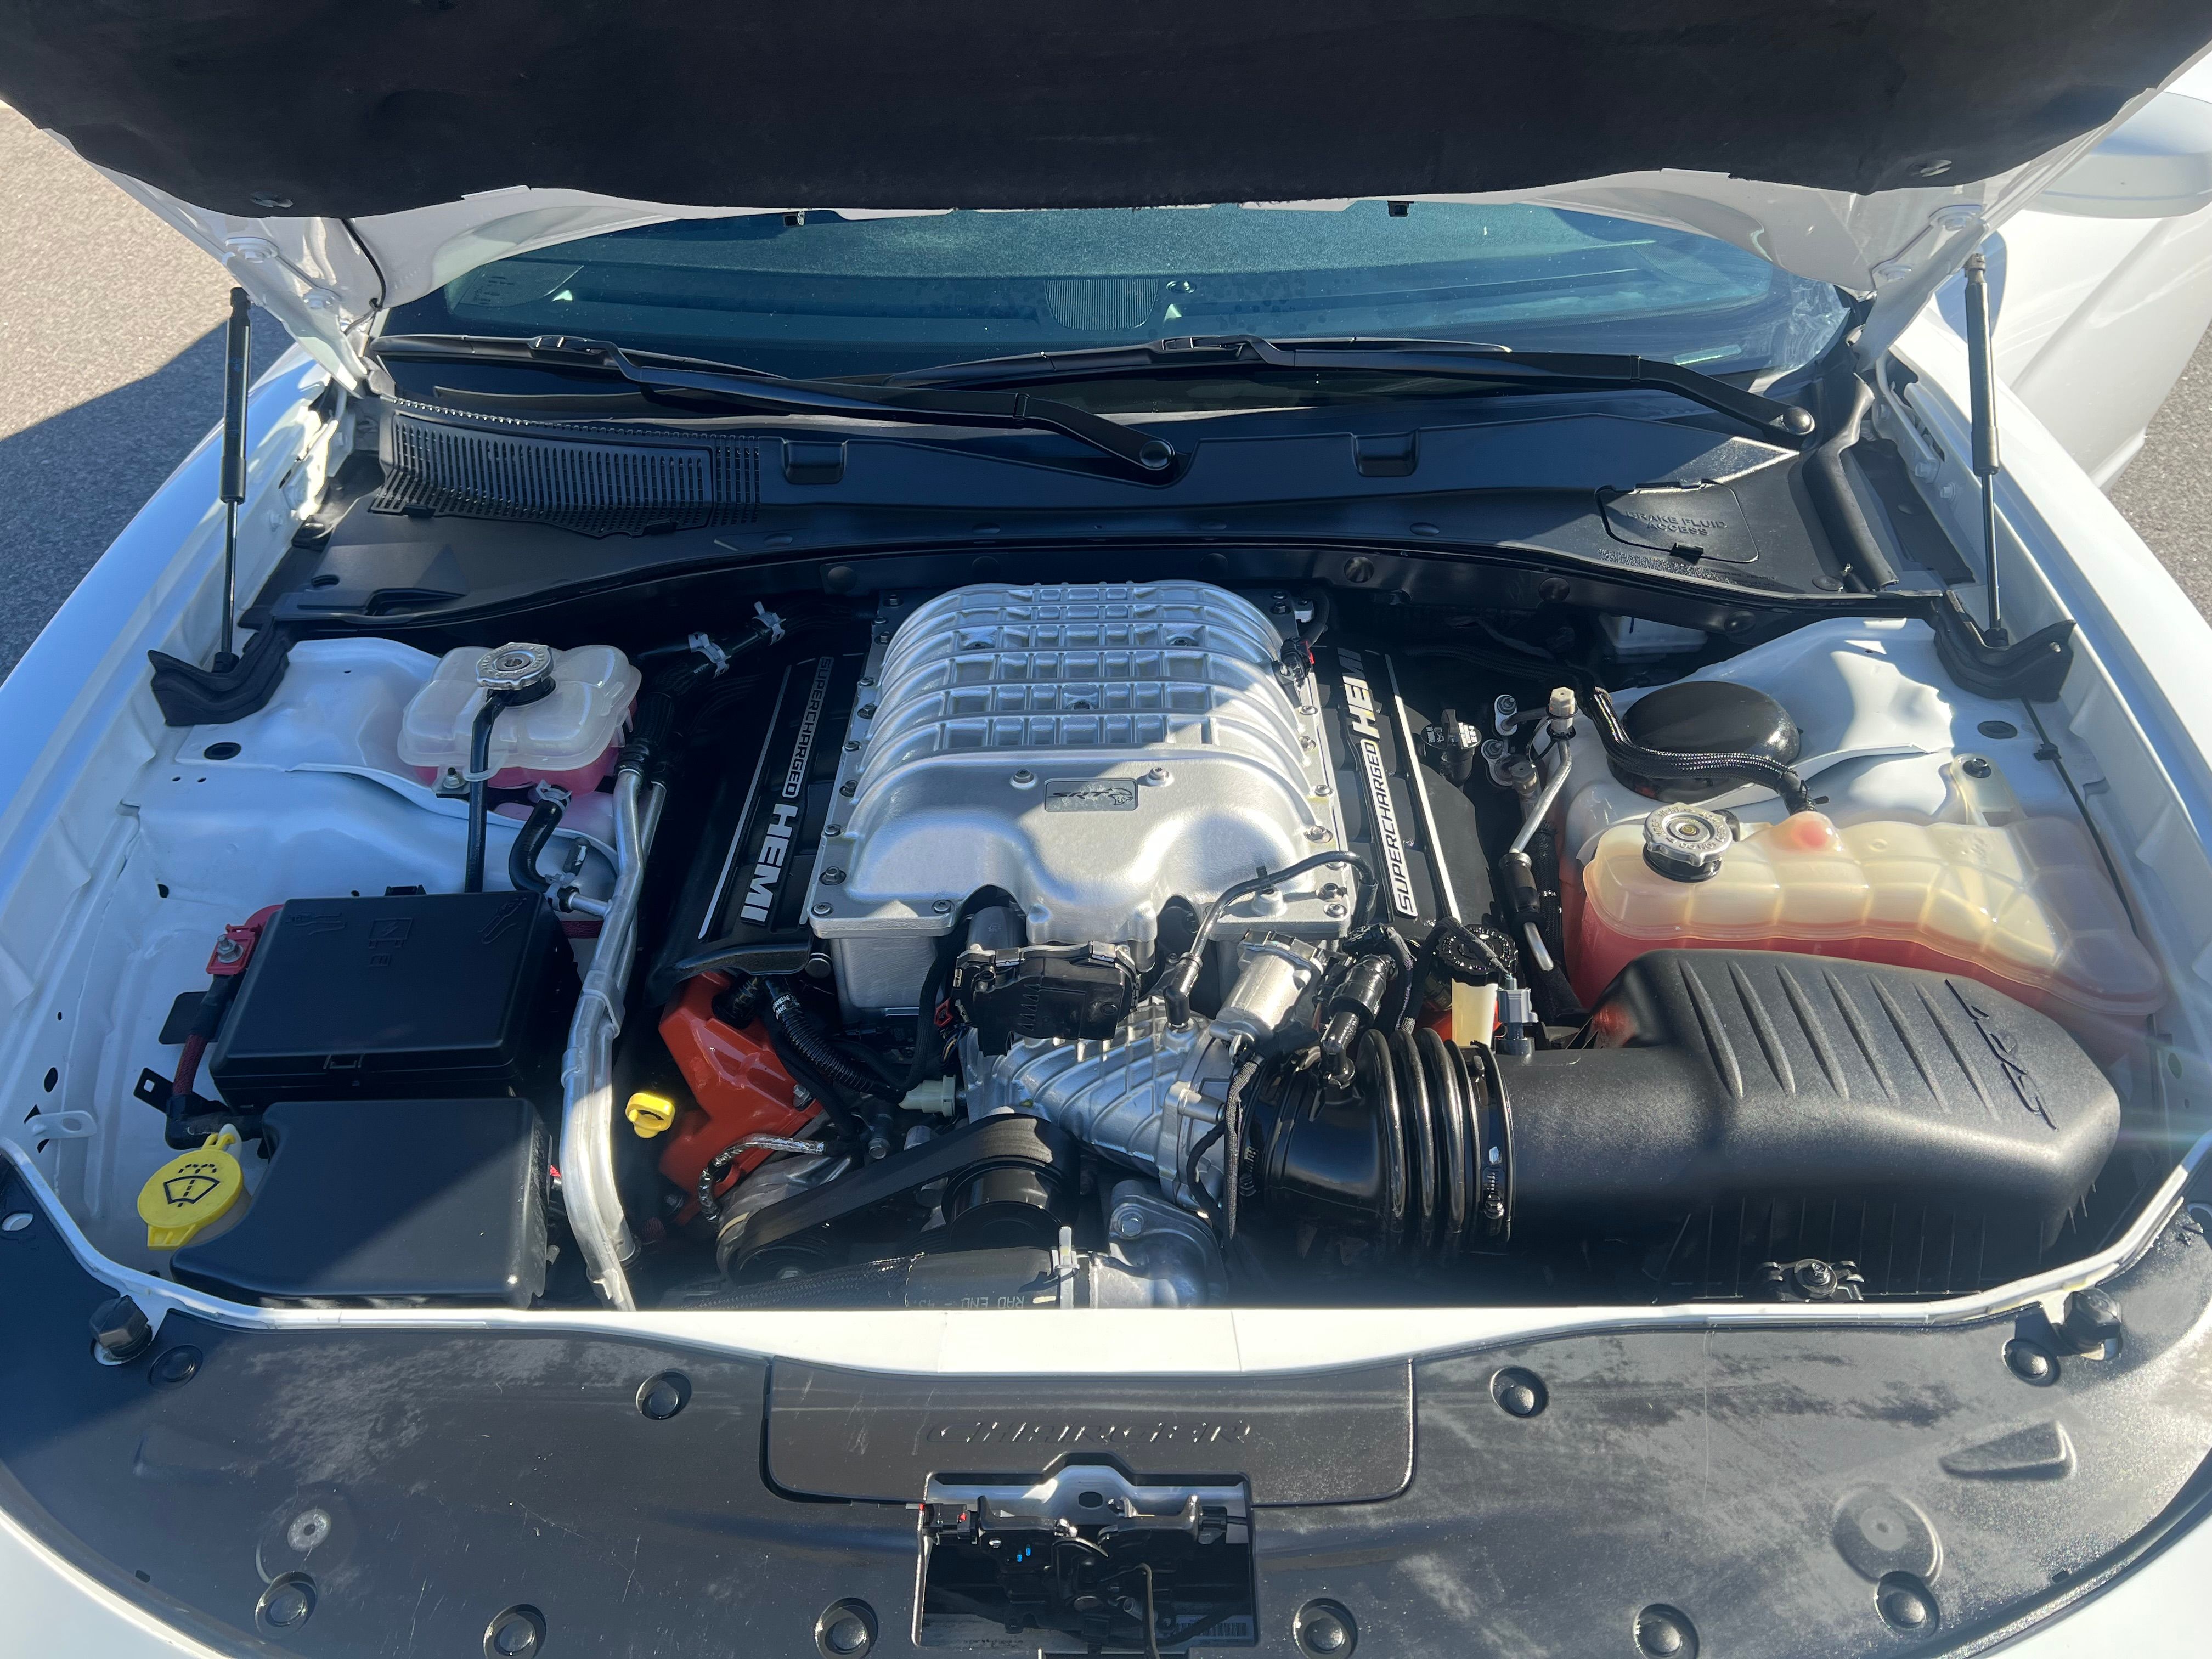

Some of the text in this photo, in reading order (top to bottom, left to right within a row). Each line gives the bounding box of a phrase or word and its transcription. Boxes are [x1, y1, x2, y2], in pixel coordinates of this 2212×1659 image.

[1625, 511, 1728, 528] BRAKE FLUID
[1647, 522, 1709, 535] ACCESS
[1338, 647, 1416, 915] SUPERCHARGED HEMI
[741, 658, 833, 922] SUPERCHARGED HEMI
[1048, 791, 1109, 799] SRT
[997, 1296, 1025, 1310] RAD
[926, 1420, 1252, 1443] CHARGER
